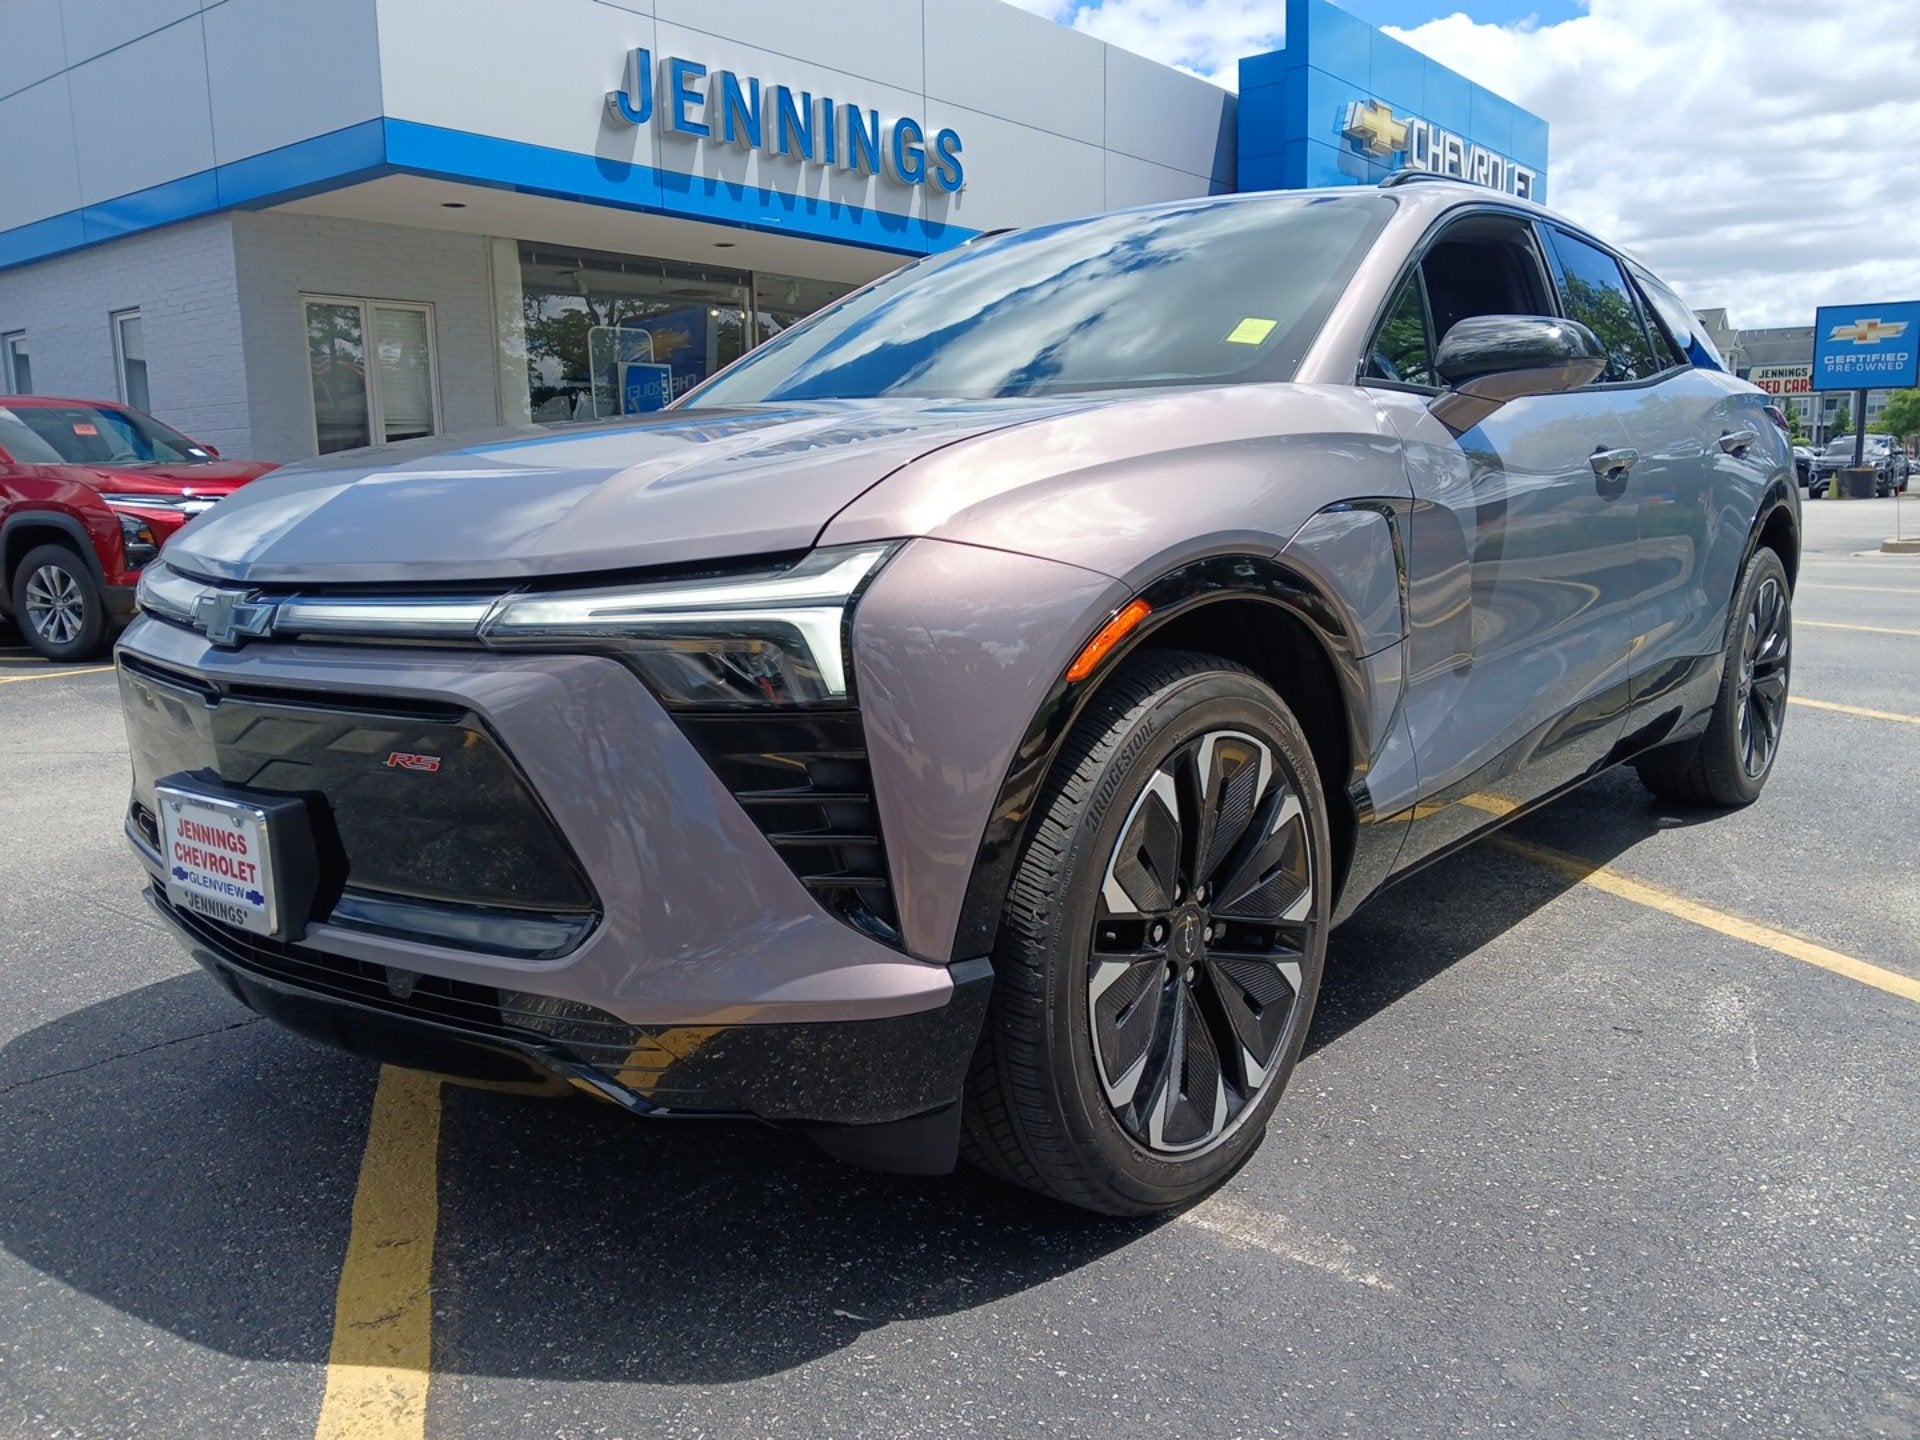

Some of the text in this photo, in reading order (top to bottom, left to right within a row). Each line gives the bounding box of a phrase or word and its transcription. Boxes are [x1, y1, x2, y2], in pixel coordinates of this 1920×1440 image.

[606, 47, 964, 195] JENNINGS
[1405, 117, 1537, 200] CHEVROLET
[1759, 367, 1808, 379] JENNINGS
[1823, 352, 1909, 365] CERTIFIED
[1827, 361, 1904, 373] PRE-OWNED
[387, 752, 441, 772] RS
[1086, 717, 1157, 834] BRIDGESTONE
[177, 818, 248, 855] JENNINGS
[174, 842, 256, 884] CHEVROLET
[189, 871, 245, 899] GLENVIEW
